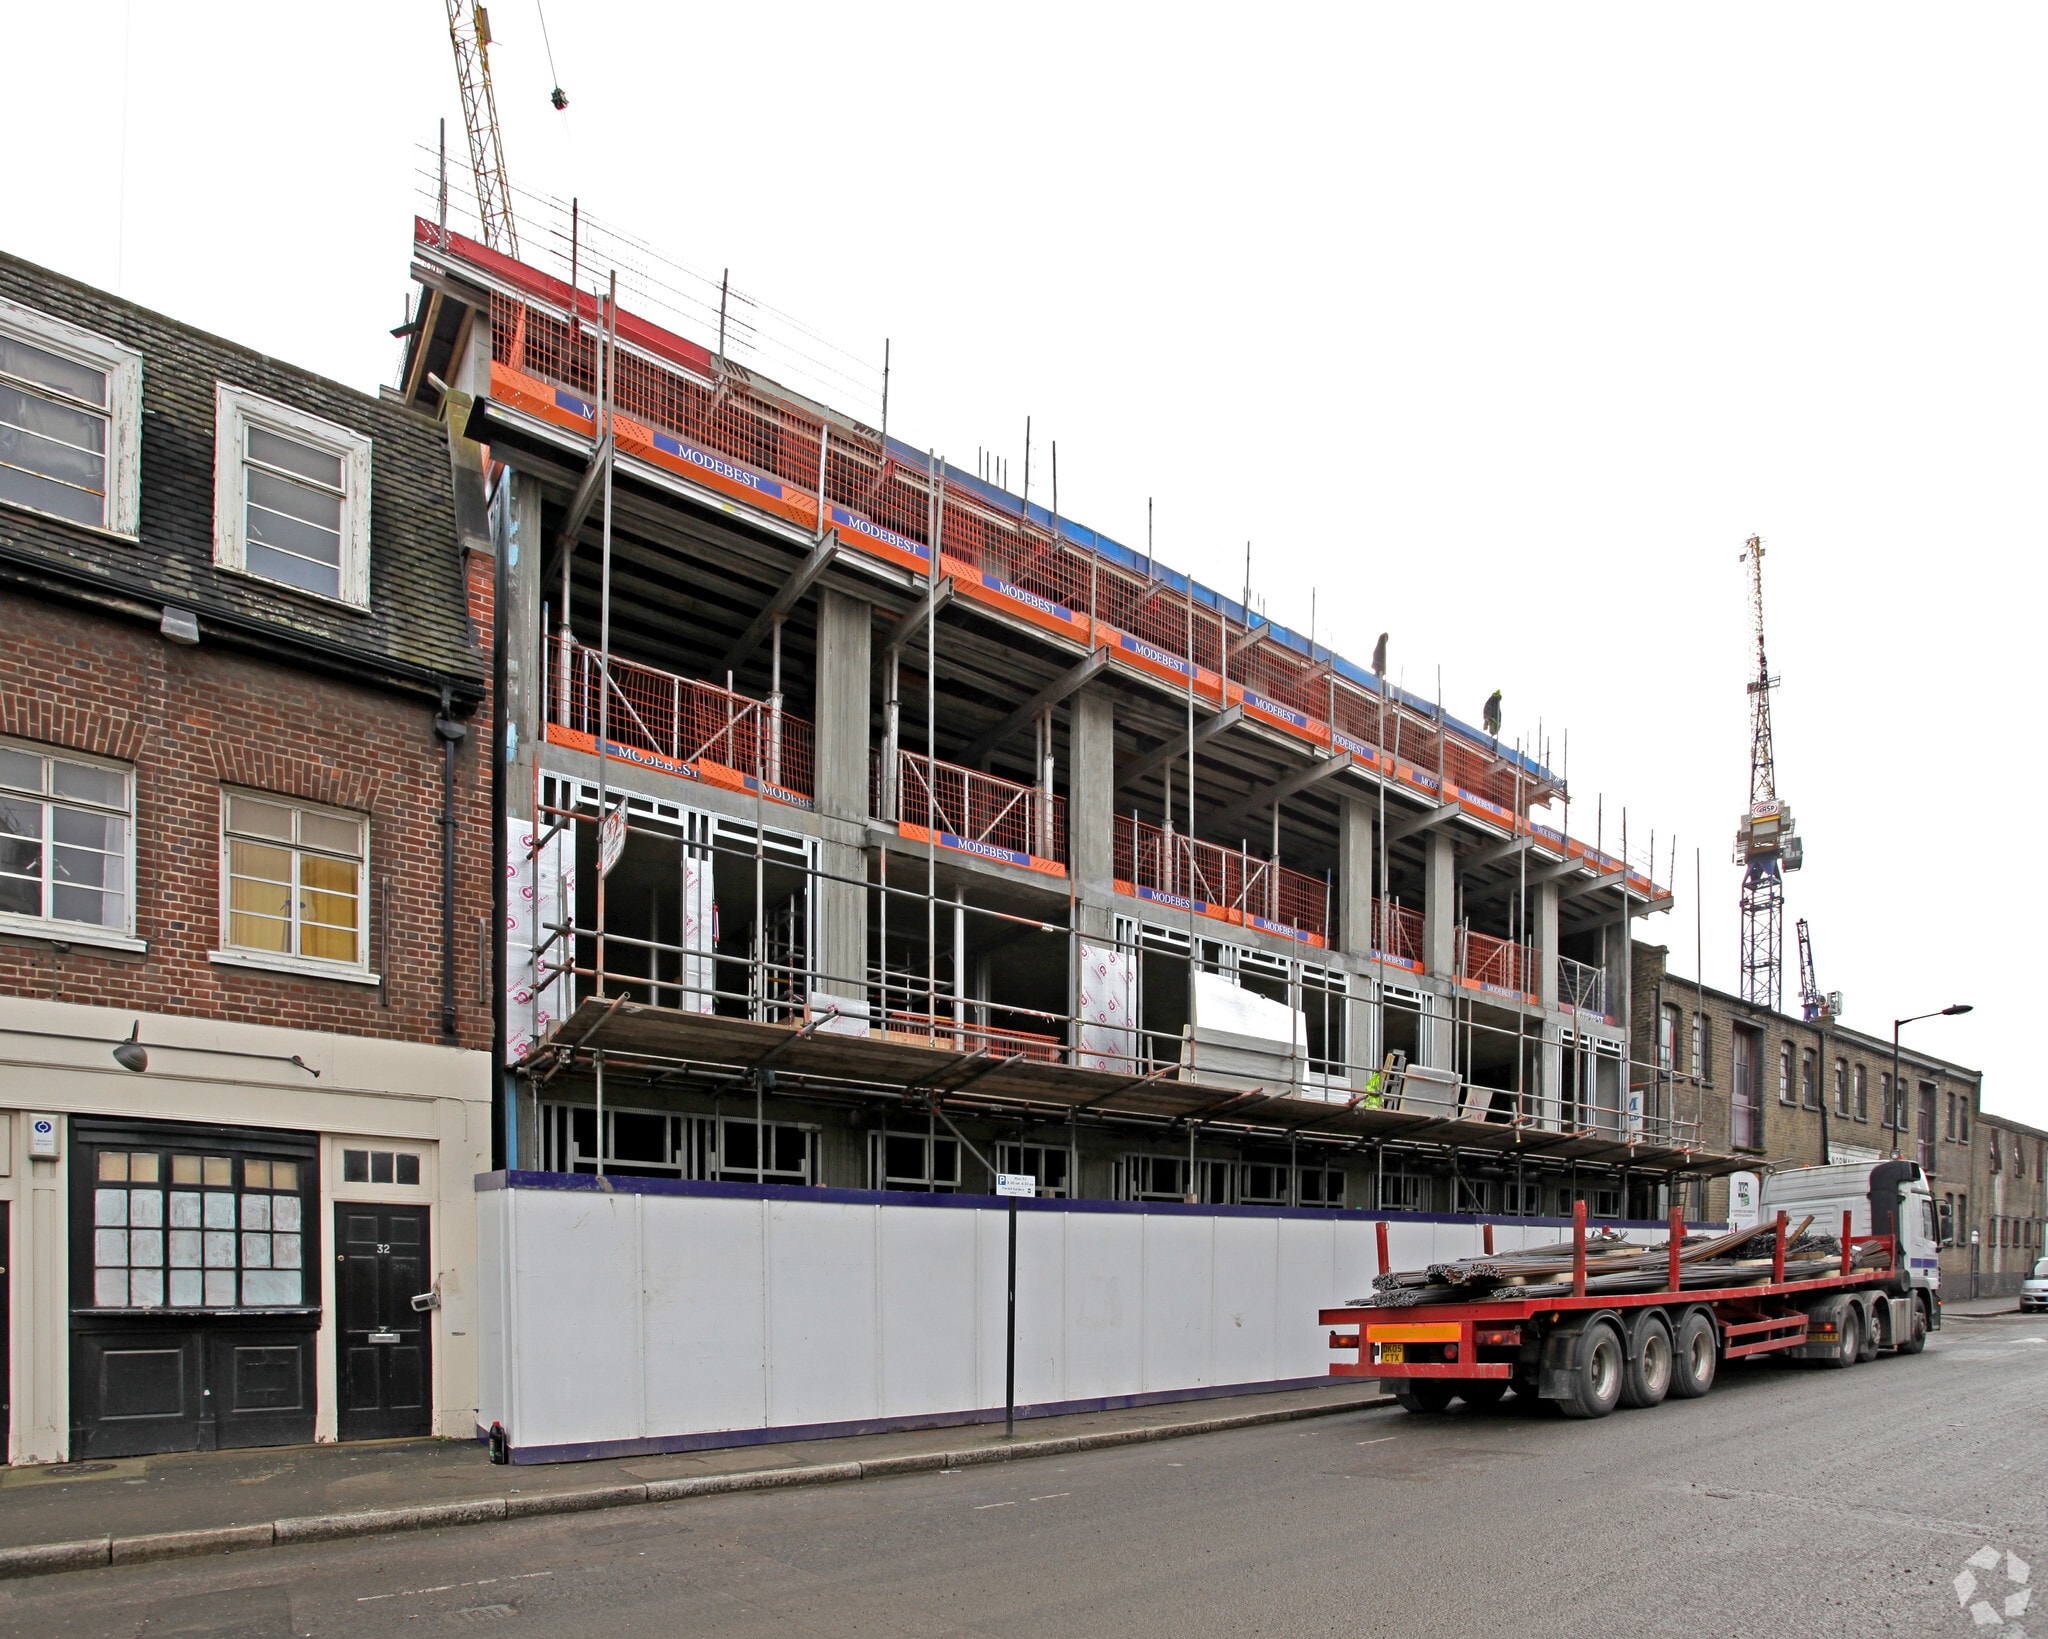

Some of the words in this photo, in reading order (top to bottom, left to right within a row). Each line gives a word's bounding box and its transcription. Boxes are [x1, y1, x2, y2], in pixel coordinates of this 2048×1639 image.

[678, 444, 760, 489] MODEBEST
[848, 515, 919, 554] MODEBEST
[999, 581, 1057, 615] MODEBEST
[1135, 642, 1184, 672] MODEBEST
[1254, 697, 1296, 723] MODEBEST
[957, 838, 1015, 862] MODEBEST
[1151, 890, 1193, 909] MODEBES
[1263, 919, 1299, 937] MODEBES
[376, 1243, 390, 1254] 32
[1384, 1353, 1400, 1362] CTX
